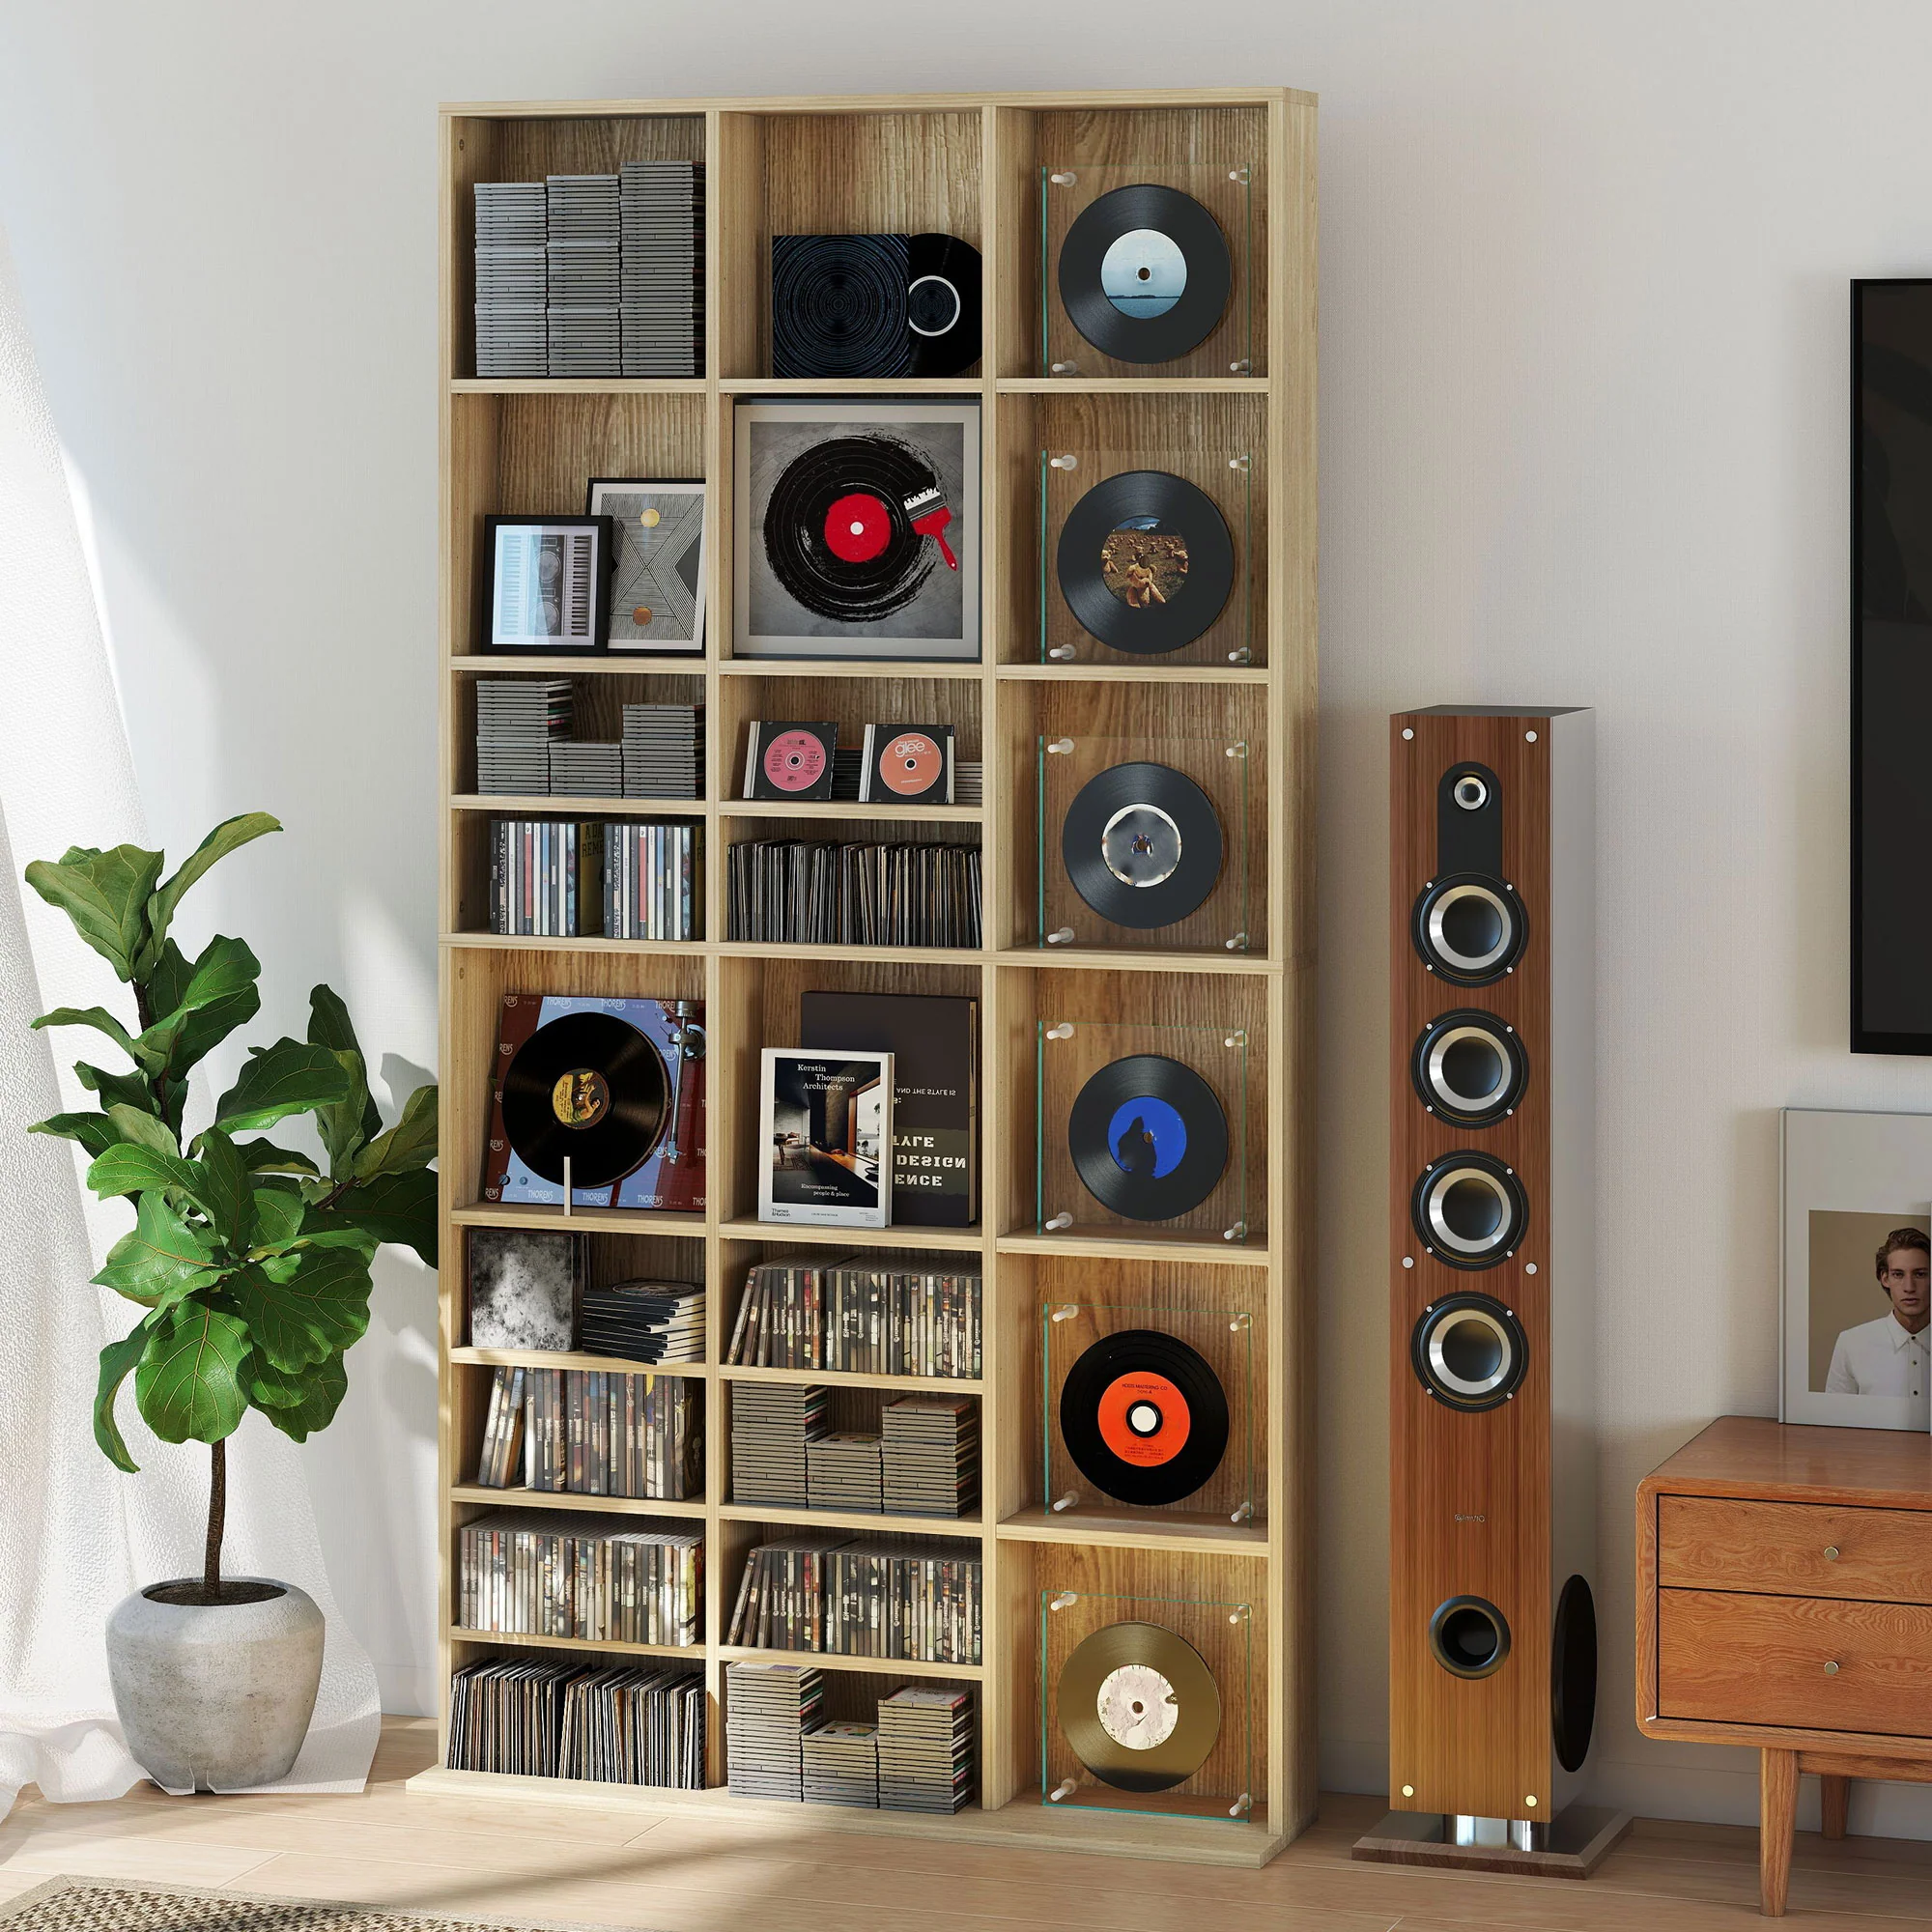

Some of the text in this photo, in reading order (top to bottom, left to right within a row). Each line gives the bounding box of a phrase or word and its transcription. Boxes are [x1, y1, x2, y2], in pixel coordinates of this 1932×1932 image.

[895, 741, 925, 758] glee
[547, 997, 572, 1009] THORENS
[601, 999, 627, 1011] THORENS
[655, 1000, 676, 1013] THORE
[797, 1064, 827, 1072] Kerstin
[814, 1073, 856, 1083] Thompson
[802, 1082, 843, 1091] Architects
[527, 1189, 554, 1203] THORENS
[582, 1192, 609, 1205] THORENS
[638, 1194, 664, 1207] THORENS
